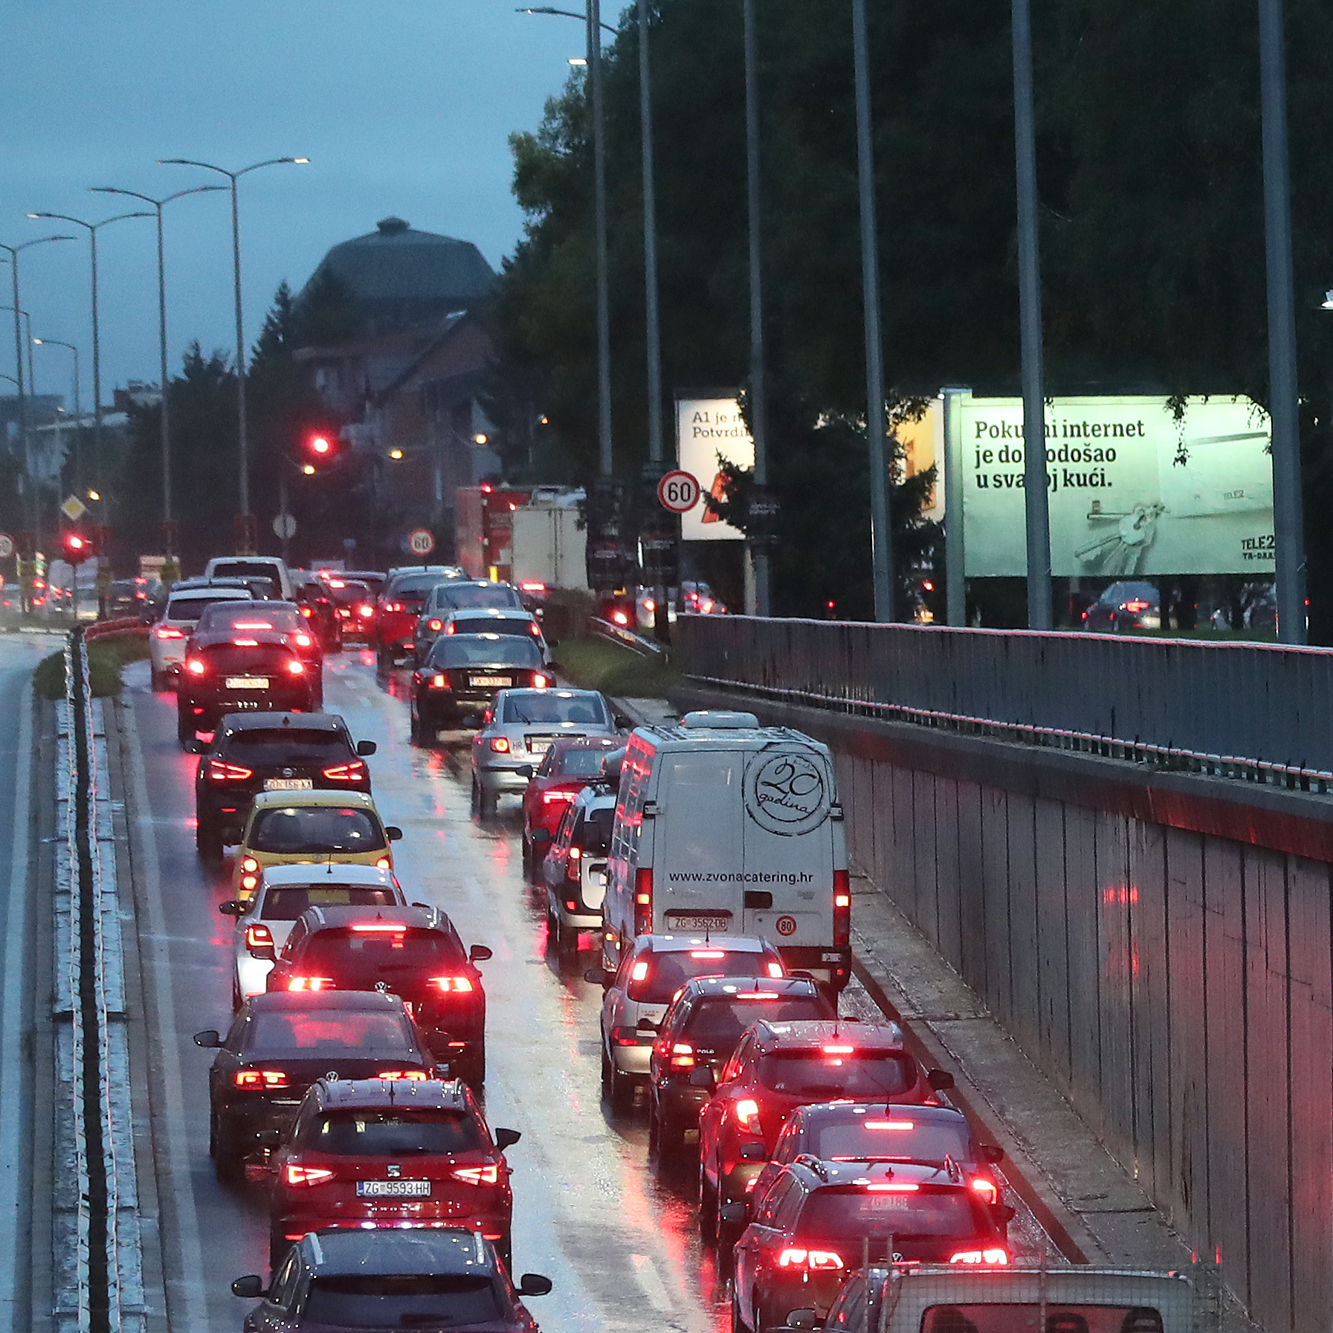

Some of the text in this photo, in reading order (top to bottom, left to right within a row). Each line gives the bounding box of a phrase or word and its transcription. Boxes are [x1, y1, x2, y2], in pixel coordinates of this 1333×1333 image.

[1062, 419, 1146, 438] internet
[974, 442, 1117, 469] je doodošao
[976, 473, 989, 489] u
[1062, 467, 1113, 488] kući.
[668, 481, 691, 502] 60
[1241, 534, 1275, 550] TELE2
[669, 871, 814, 886] www.zvonacatering.hr
[780, 920, 791, 932] 80
[365, 1182, 379, 1195] ZG
